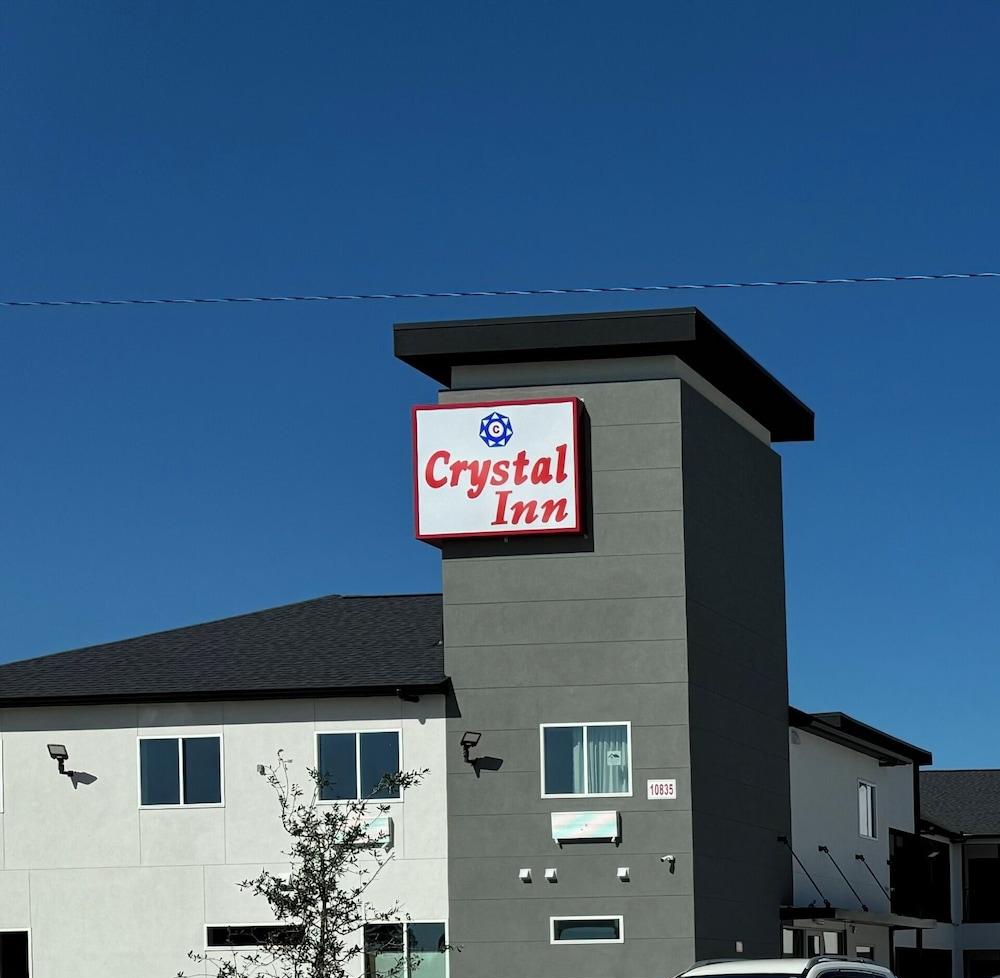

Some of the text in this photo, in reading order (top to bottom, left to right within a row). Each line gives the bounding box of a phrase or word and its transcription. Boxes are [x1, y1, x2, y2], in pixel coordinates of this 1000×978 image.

[492, 425, 500, 434] C
[425, 443, 568, 499] Crystal
[491, 490, 568, 526] Inn
[650, 783, 674, 796] 10835
